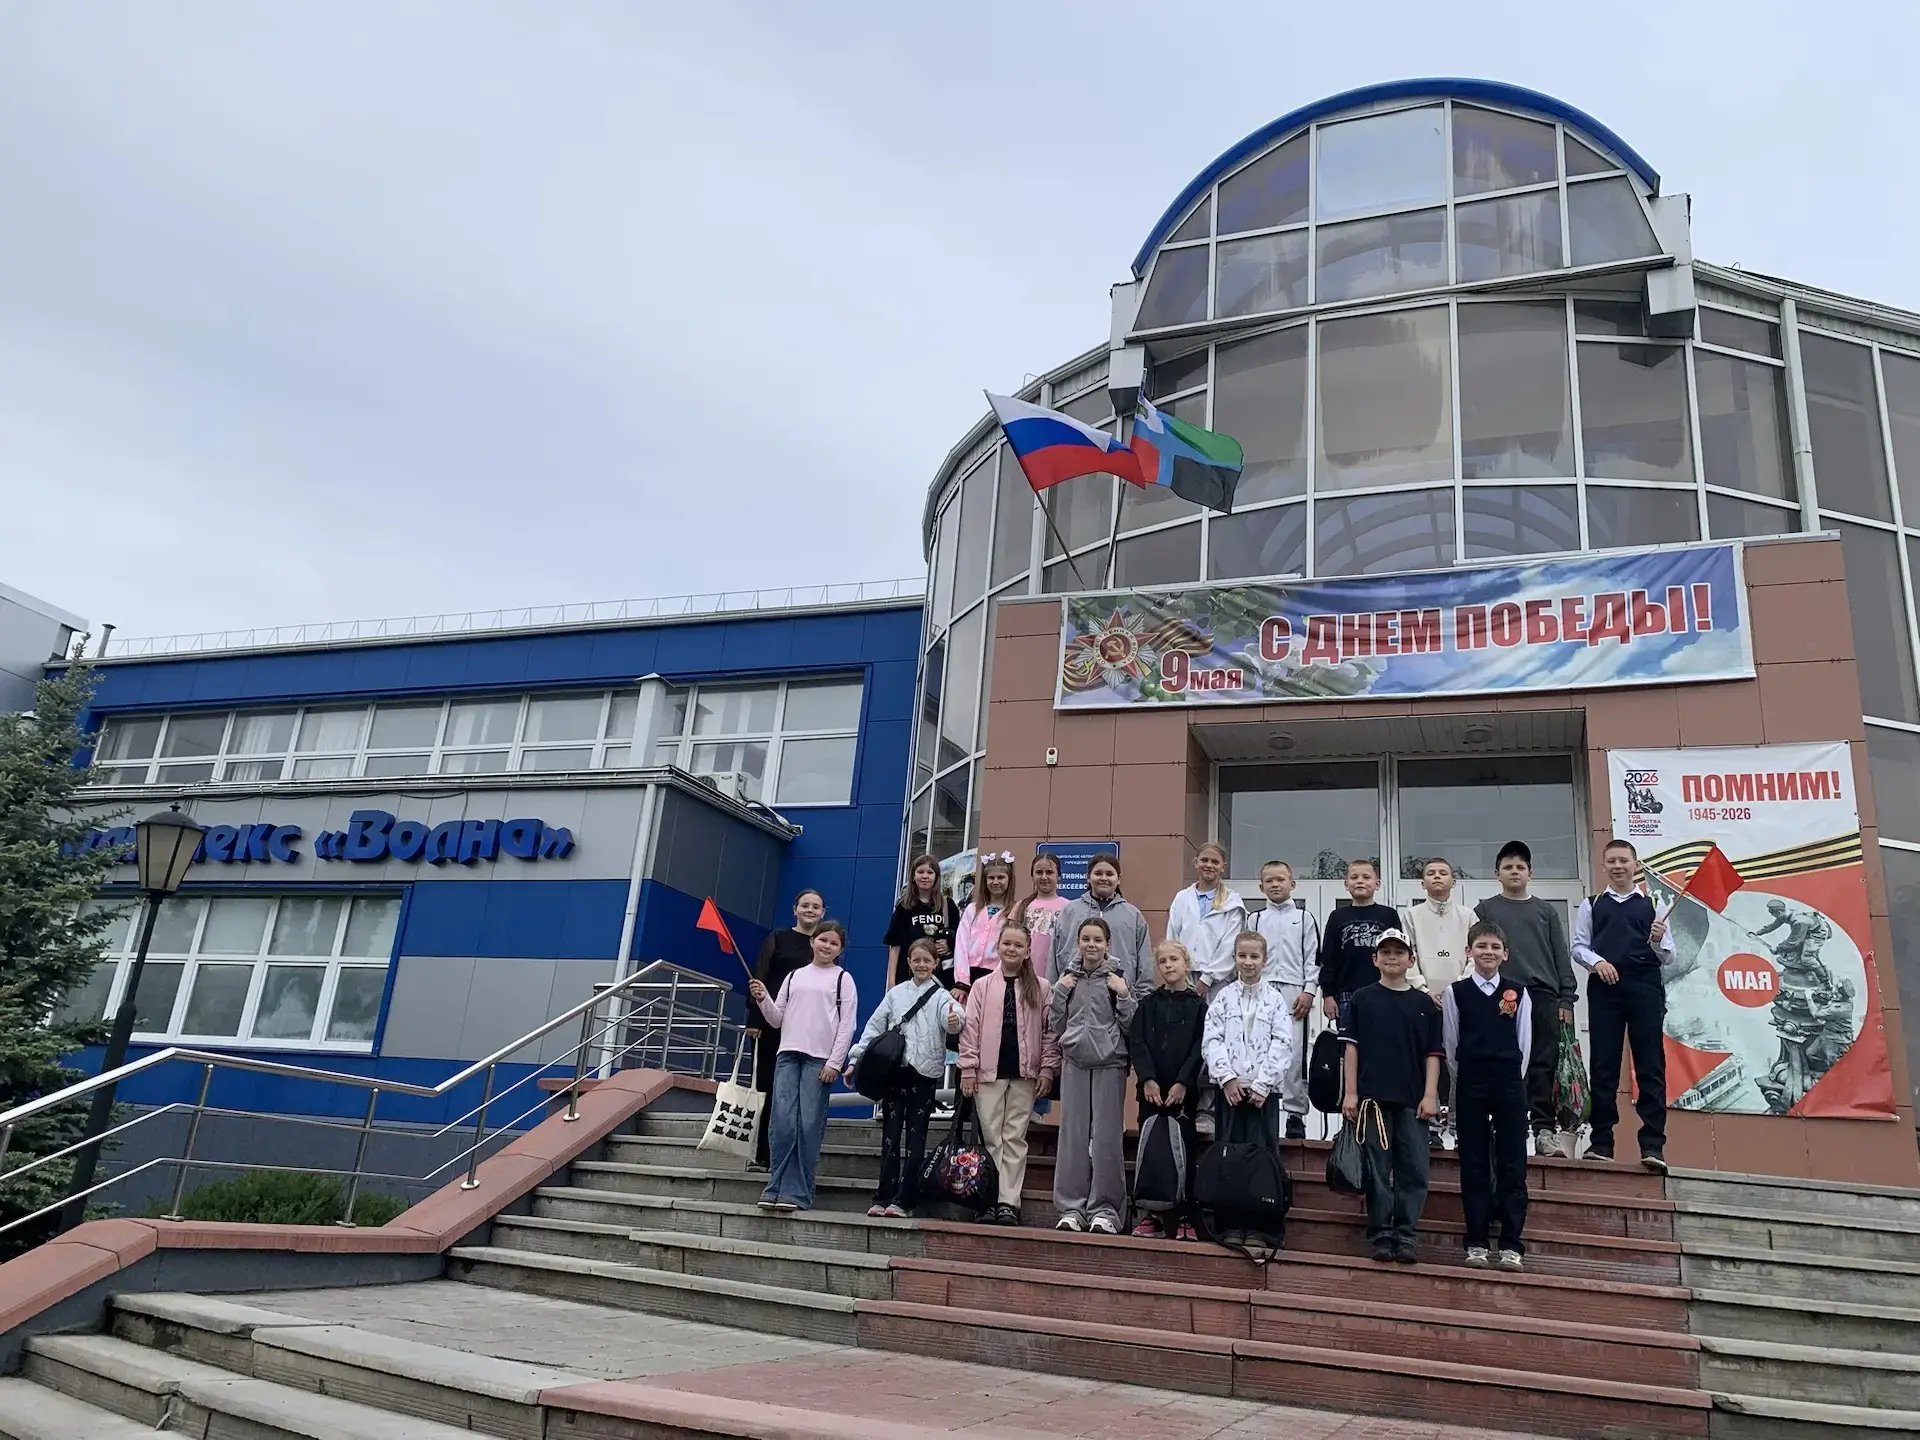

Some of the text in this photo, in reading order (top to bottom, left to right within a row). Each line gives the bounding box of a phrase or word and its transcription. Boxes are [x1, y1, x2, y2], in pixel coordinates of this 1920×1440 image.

[1260, 582, 1714, 665] С ДНЕМ ПОБЕДЫ!
[1626, 772, 1659, 783] 2026
[1682, 771, 1842, 803] ПОМНИМ!
[1688, 808, 1751, 821] 1945-2026
[314, 809, 576, 866] «Волна»
[1723, 970, 1773, 990] МАЯ
